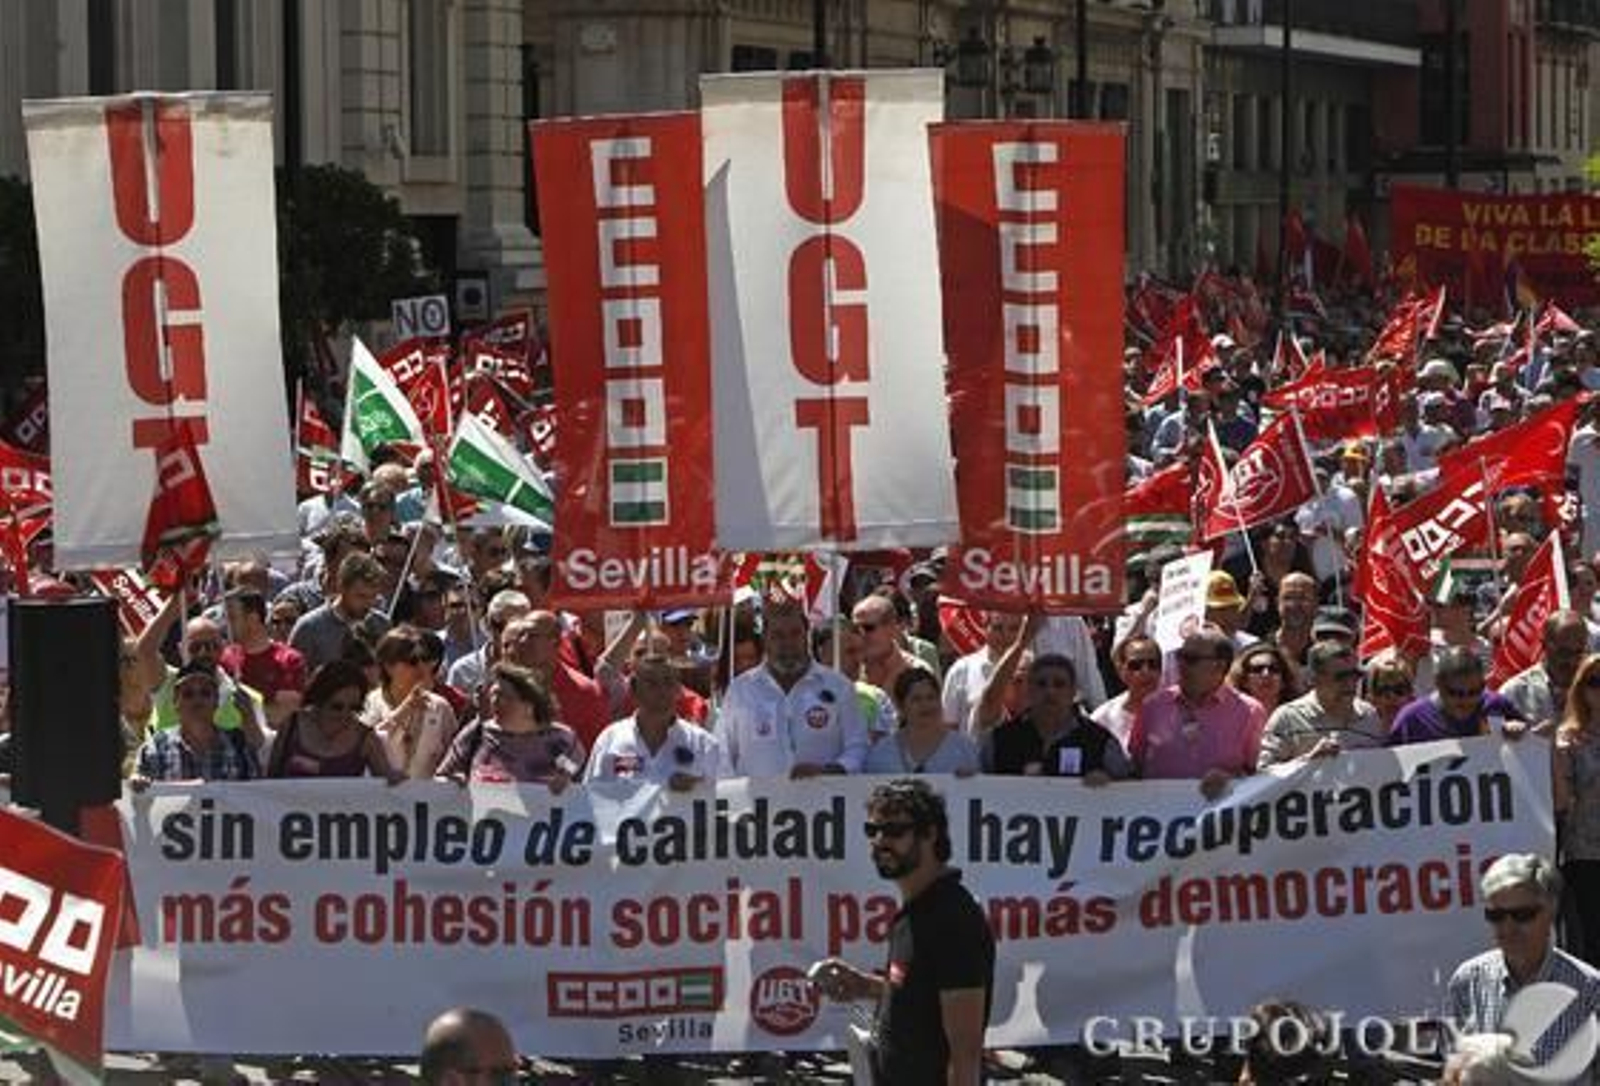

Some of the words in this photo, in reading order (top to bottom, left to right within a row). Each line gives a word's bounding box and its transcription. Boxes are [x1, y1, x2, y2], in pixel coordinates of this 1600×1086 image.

[1462, 202, 1530, 226] VIVA
[1540, 203, 1575, 226] LA
[1415, 222, 1452, 249] DE
[1507, 230, 1584, 256] CLAS
[396, 299, 446, 334] NO
[591, 137, 667, 449] CCOO
[782, 78, 870, 541] UGT
[993, 142, 1061, 454] CCOO
[566, 545, 719, 591] Sevilla
[960, 547, 1112, 596] Sevilla
[162, 801, 254, 861] sin
[278, 802, 504, 874] empleo
[524, 805, 594, 867] de
[616, 796, 846, 866] calidad
[968, 798, 1078, 879] hay
[1101, 756, 1515, 864] recuperación
[0, 866, 105, 975] OO
[161, 875, 292, 943] más
[313, 878, 592, 946] cohesión
[610, 877, 802, 948] social
[827, 890, 902, 958] pa
[988, 880, 1116, 942] más
[0, 963, 82, 1021] villa
[557, 976, 678, 1010] CCOO
[758, 978, 814, 1006] UGT
[618, 1015, 713, 1044] Sevilla
